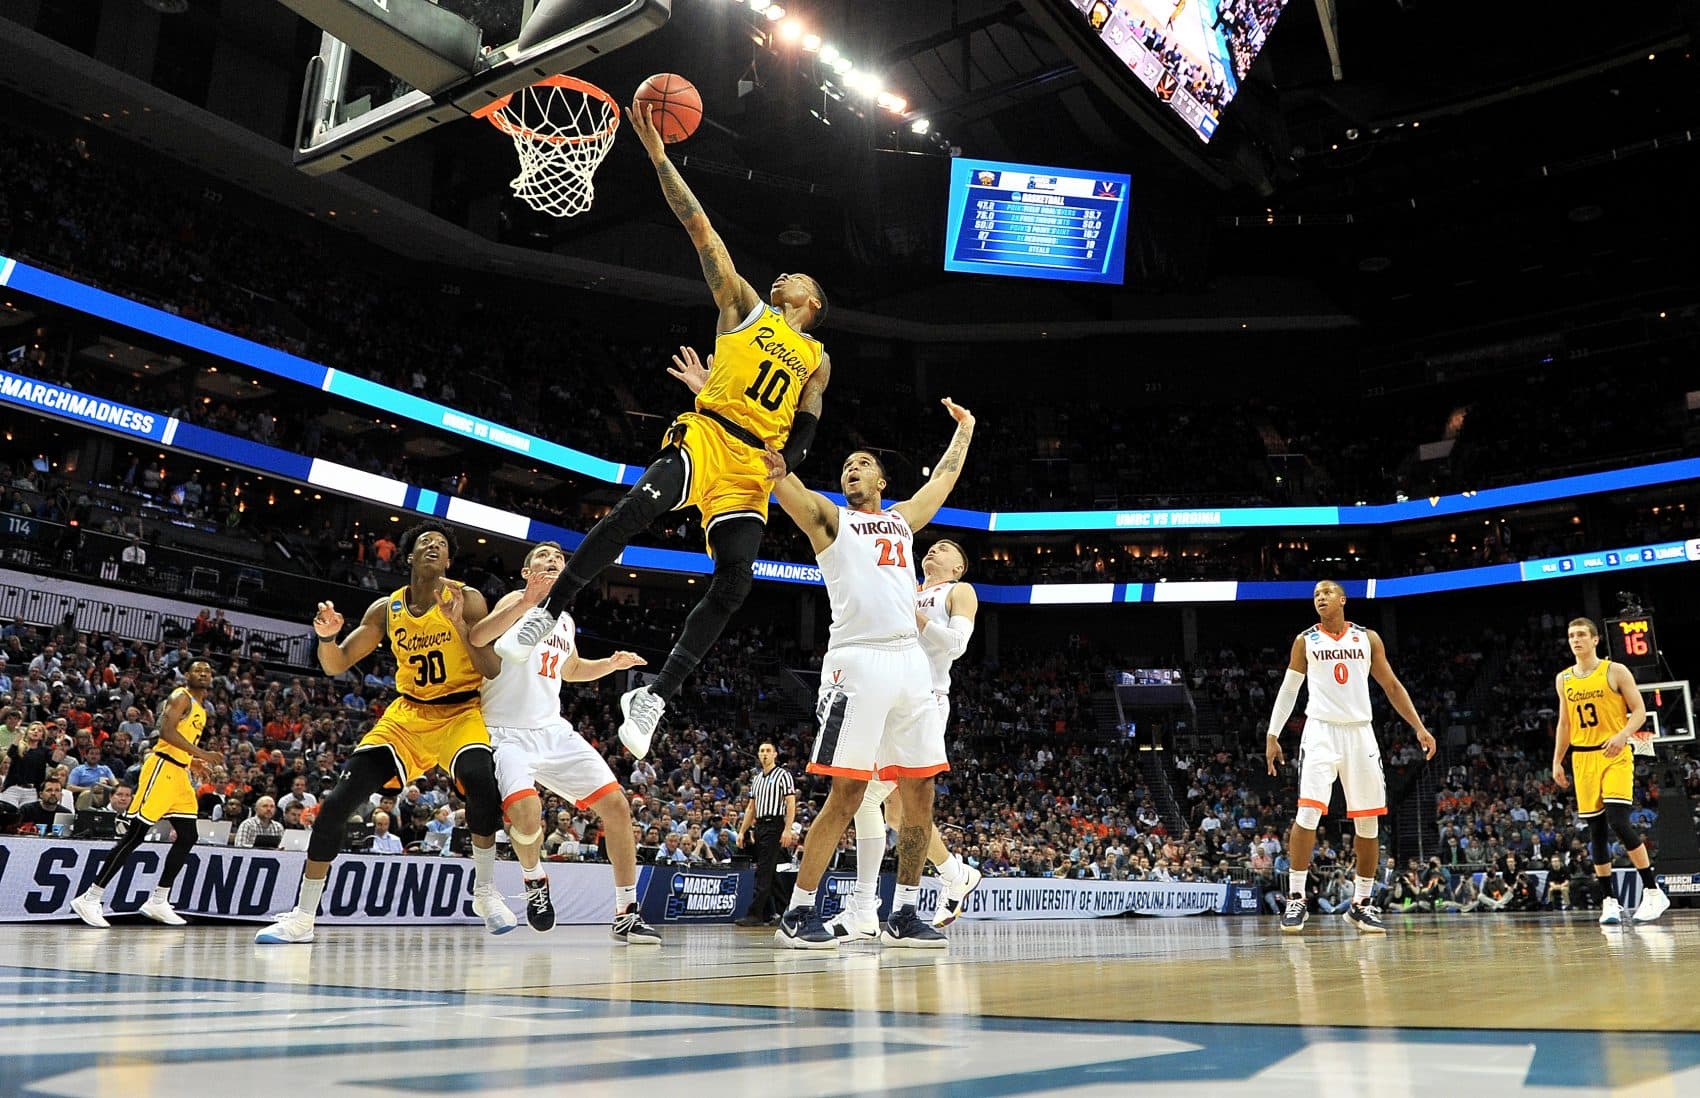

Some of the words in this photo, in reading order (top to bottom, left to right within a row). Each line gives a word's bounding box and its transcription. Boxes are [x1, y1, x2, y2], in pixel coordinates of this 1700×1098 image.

[744, 360, 791, 411] 10
[0, 374, 154, 433] MARCHMADNESS
[9, 518, 31, 535] 114
[850, 520, 911, 541] VIRGINIA
[875, 538, 907, 568] 21
[751, 562, 822, 582] CHMADNESS
[395, 627, 451, 652] Retrievers
[544, 634, 571, 655] GINIA
[1625, 633, 1649, 656] 16
[537, 650, 559, 679] 11
[1312, 648, 1365, 661] VIRGINIA
[409, 650, 447, 687] 30
[1334, 662, 1349, 685] 0
[1576, 703, 1599, 729] 13
[683, 877, 721, 894] MARCH
[837, 880, 856, 894] MAR
[686, 894, 736, 911] MADNESS
[918, 888, 969, 912] HOD
[973, 889, 988, 912] BY
[992, 889, 1012, 912] THE
[1015, 889, 1075, 912] UNIVERSITY
[1079, 891, 1093, 911] OF
[1094, 891, 1125, 911] NORTH
[1125, 890, 1165, 911] CAROLINA
[1166, 892, 1175, 911] AT
[1176, 891, 1219, 911] CHARLOTTE
